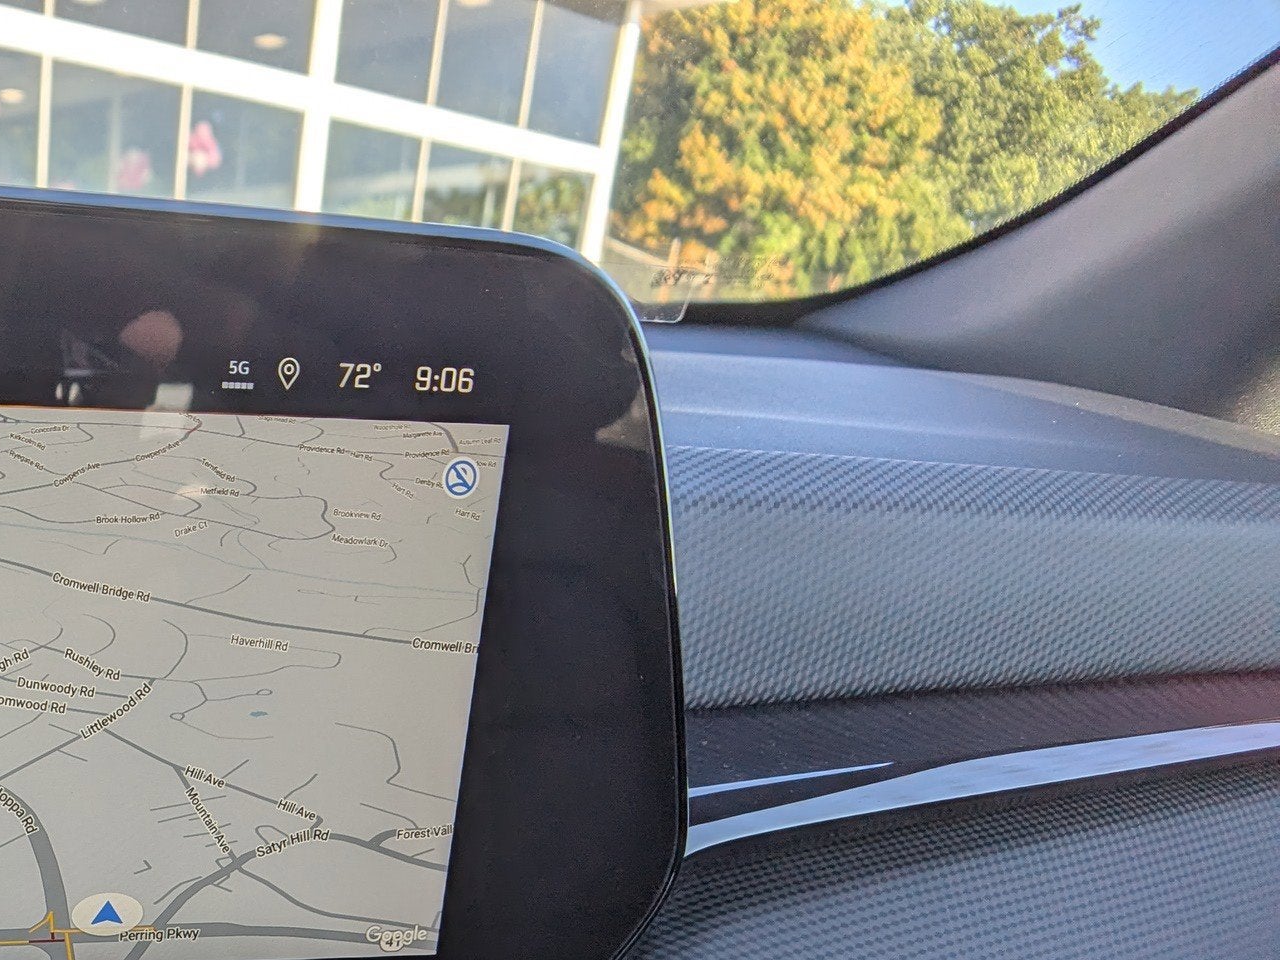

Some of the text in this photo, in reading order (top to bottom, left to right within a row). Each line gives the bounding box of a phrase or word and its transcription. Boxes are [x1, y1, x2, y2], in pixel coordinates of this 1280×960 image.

[228, 361, 250, 375] 5G
[338, 362, 382, 389] 72°
[415, 366, 475, 393] 9:06
[36, 442, 46, 451] Rd
[135, 440, 182, 462] Cowpens Ave
[299, 444, 345, 455] Providence Rd
[404, 450, 440, 459] Providence
[9, 450, 45, 471] Ryegate Rd
[53, 461, 101, 488] Cowpens Ave
[225, 472, 236, 482] Rd
[229, 487, 240, 497] Rd
[392, 482, 414, 499] Hart Rd
[96, 512, 161, 524] Brook Hollow Rd
[333, 508, 382, 521] Brookview Rd
[455, 508, 481, 521] Hart Rd
[174, 521, 208, 538] Drake Ct
[331, 533, 389, 548] Meadowlark Dr
[52, 573, 150, 602] Cromwell Bridge Rd
[230, 634, 289, 652] Haverhill Rd
[412, 637, 463, 652] Cromwell
[12, 648, 30, 664] Rd
[64, 648, 121, 681] Rushley Rd
[17, 677, 96, 699] Dunwoody Rd
[50, 701, 67, 714] Rd
[80, 682, 152, 740] Littlewood Rd
[184, 765, 225, 788] Hill Ave
[277, 799, 317, 822] Hill Ave
[21, 815, 38, 835] Rd
[185, 787, 230, 853] Mountain Ave
[396, 827, 430, 840] Forest
[256, 829, 330, 858] Satyr Hill Rd
[120, 928, 199, 942] Perring Pkwy
[366, 924, 428, 946] Google
